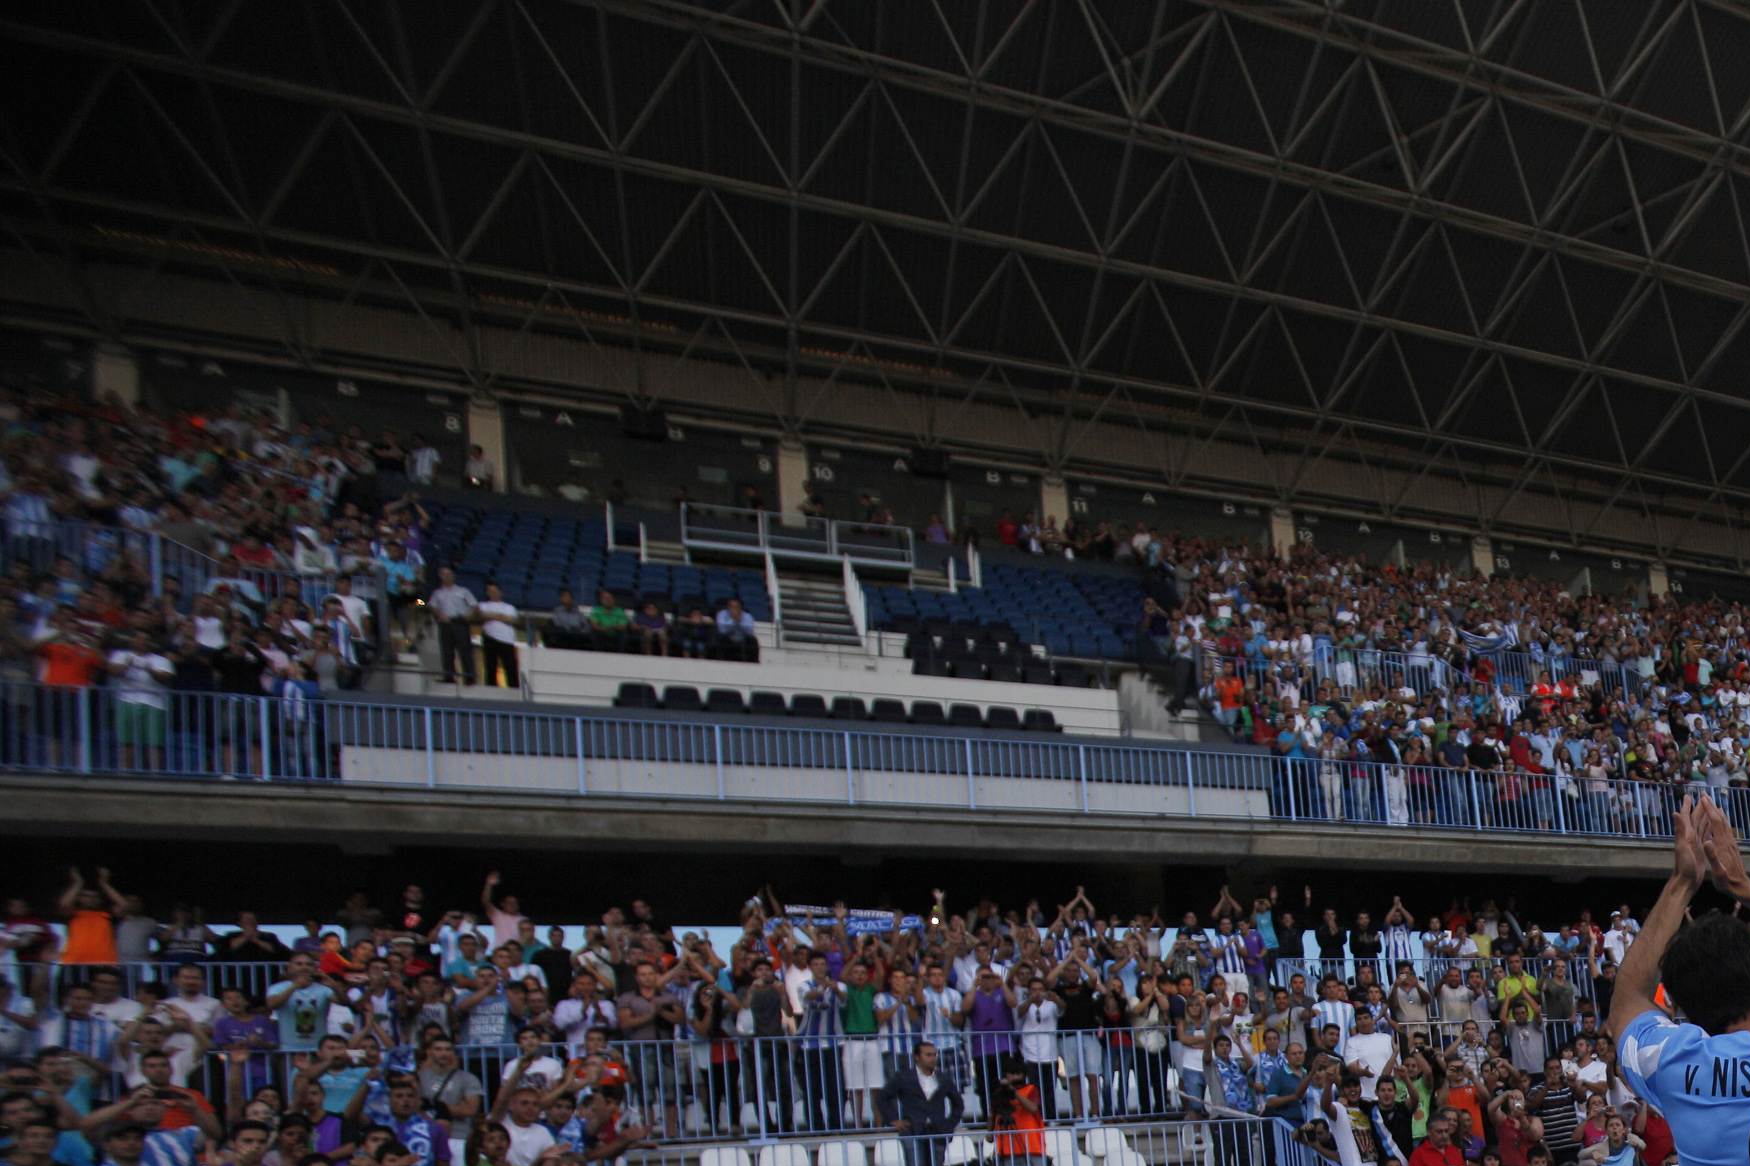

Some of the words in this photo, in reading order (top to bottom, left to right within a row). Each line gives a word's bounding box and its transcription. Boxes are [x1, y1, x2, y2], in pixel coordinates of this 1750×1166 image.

[893, 458, 909, 473] A
[813, 465, 834, 482] 10
[985, 470, 1001, 484] B
[1141, 490, 1156, 505] A
[1072, 500, 1088, 513] 11
[1222, 502, 1236, 515] B
[1297, 530, 1314, 543] 12
[1429, 531, 1441, 543] B
[1496, 556, 1510, 569] 13
[1548, 550, 1561, 562] A
[1685, 1064, 1701, 1096] V.
